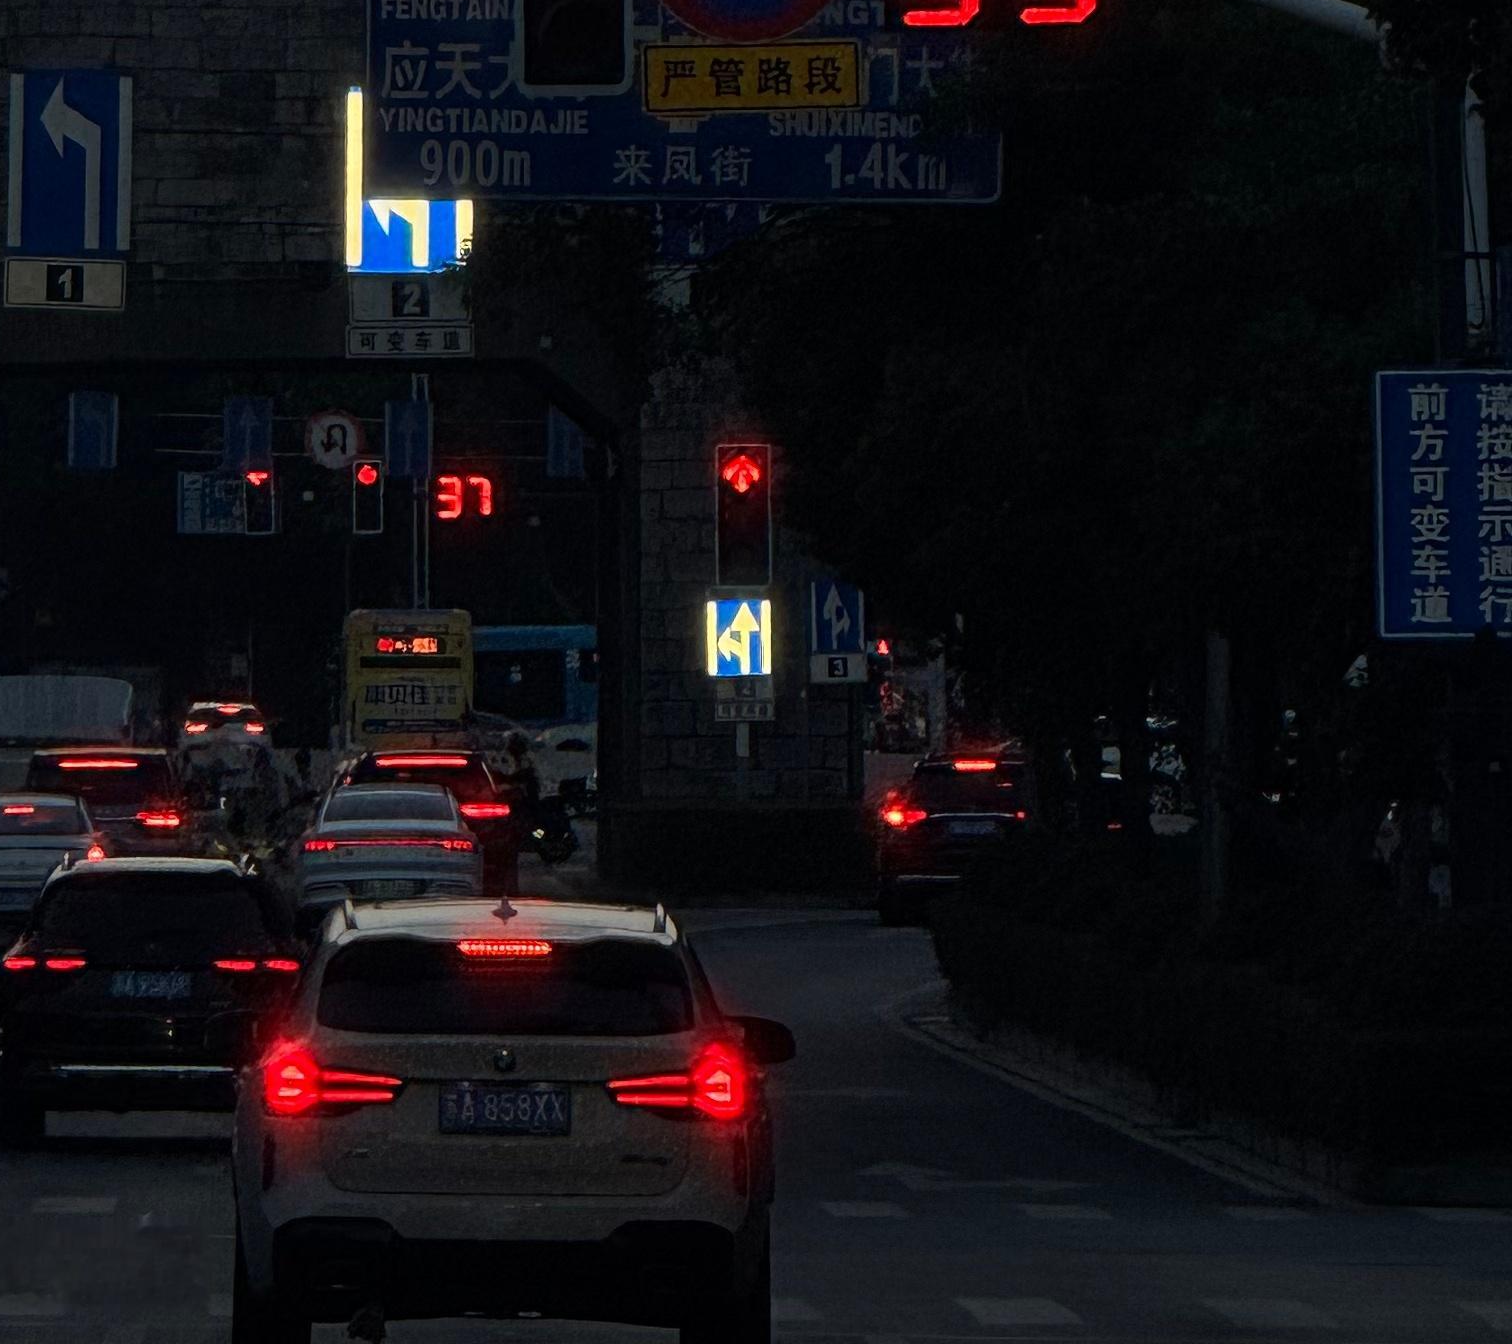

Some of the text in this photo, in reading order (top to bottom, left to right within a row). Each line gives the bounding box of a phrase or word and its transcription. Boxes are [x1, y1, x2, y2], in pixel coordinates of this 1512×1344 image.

[659, 56, 844, 98] 严管路段
[380, 108, 589, 135] YINGTIANDAJIE
[419, 139, 531, 187] 900m
[612, 143, 753, 188] 来凤街
[824, 141, 947, 191] 1.4km
[58, 267, 73, 300] 1
[402, 282, 423, 315] 2
[437, 475, 493, 520] 37
[1407, 382, 1453, 623] 前方可变车道
